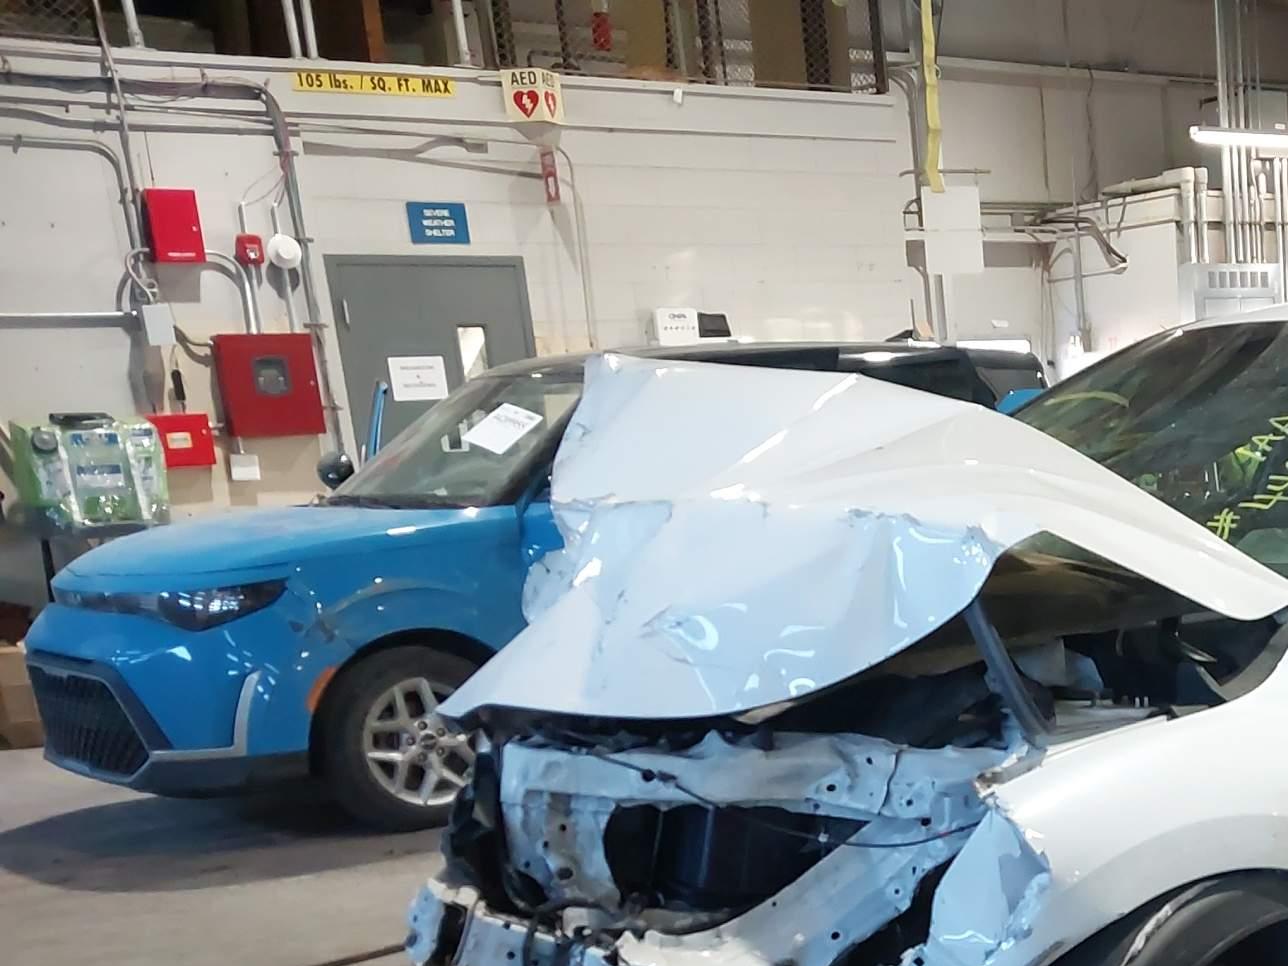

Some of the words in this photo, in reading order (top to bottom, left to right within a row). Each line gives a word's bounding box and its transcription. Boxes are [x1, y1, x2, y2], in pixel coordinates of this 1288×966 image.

[297, 73, 324, 88] 105
[329, 73, 354, 90] lbs.
[360, 75, 365, 90] /
[371, 77, 392, 92] SQ.
[399, 79, 416, 93] FT.
[422, 80, 452, 95] MAX
[511, 71, 537, 86] AED
